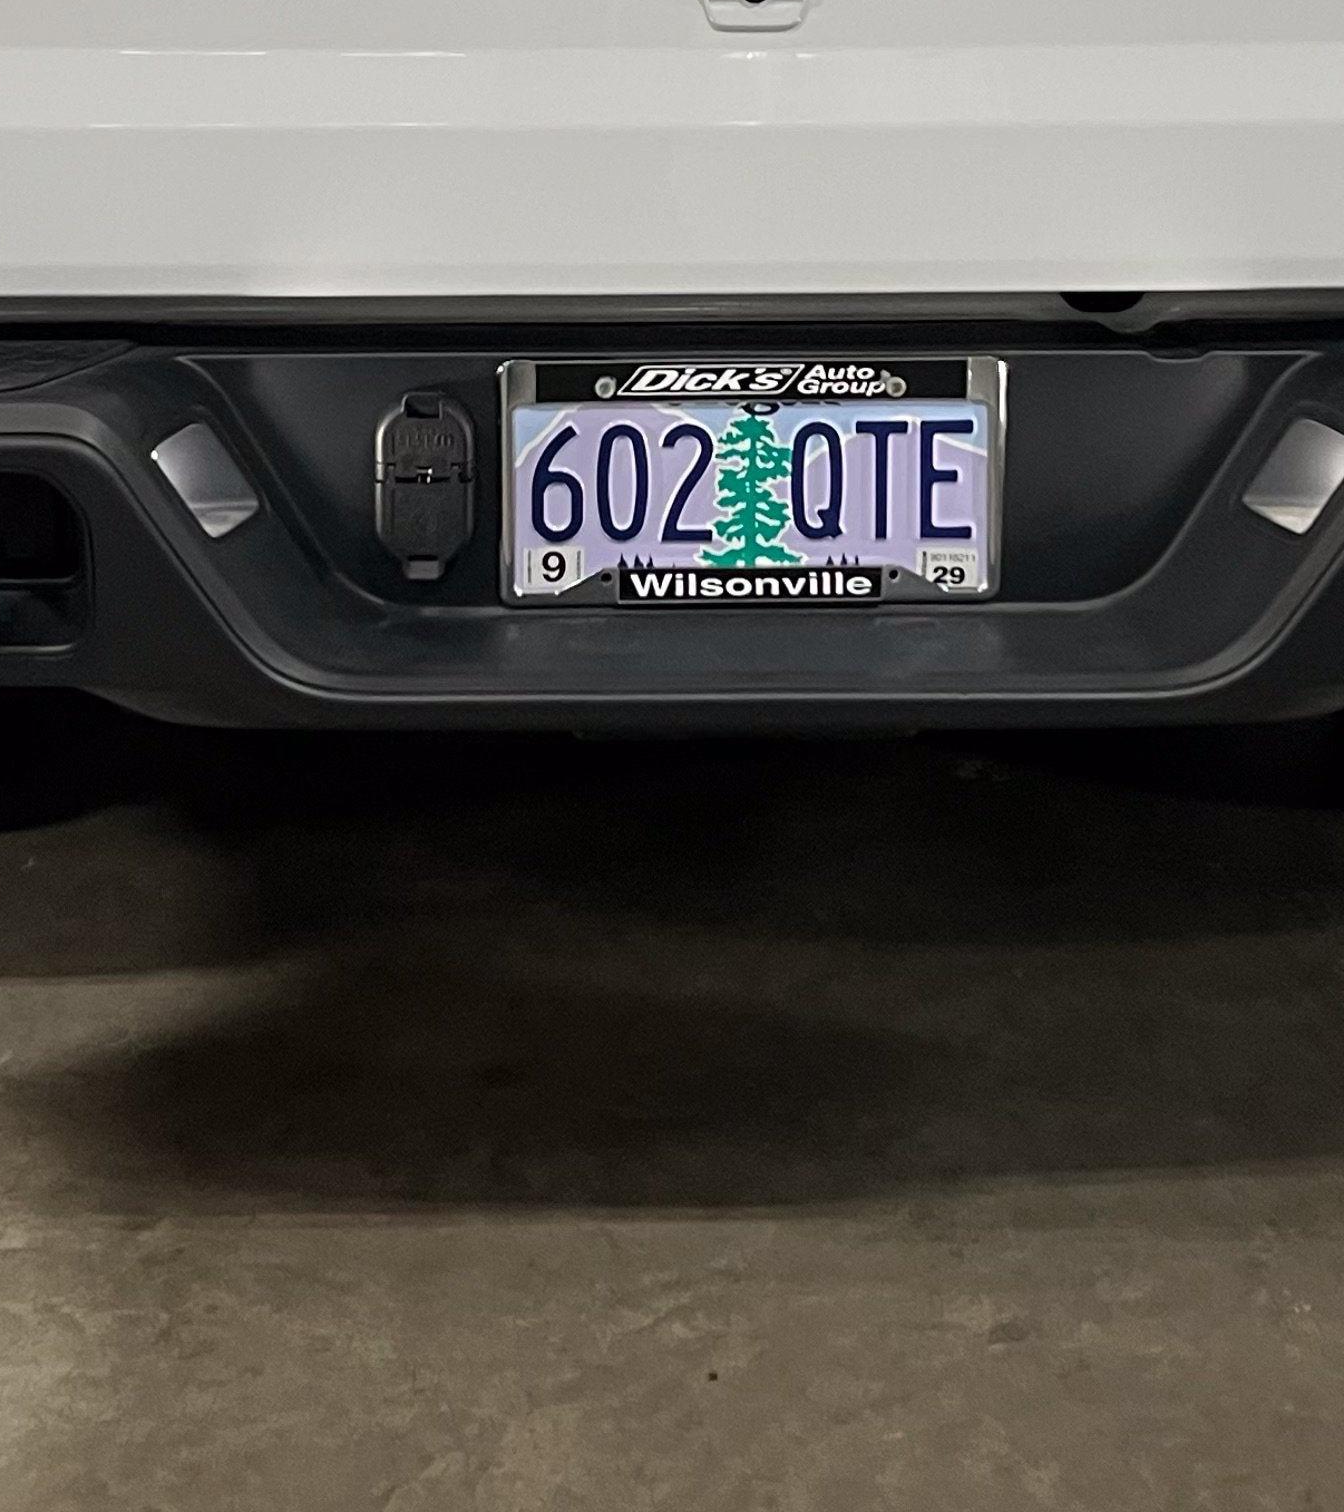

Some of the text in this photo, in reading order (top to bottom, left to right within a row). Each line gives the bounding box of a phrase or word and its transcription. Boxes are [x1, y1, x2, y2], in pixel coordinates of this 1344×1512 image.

[629, 367, 785, 392] Dick's
[803, 364, 876, 380] Auto
[796, 379, 888, 397] Group
[530, 419, 976, 543] 602 QTE
[541, 550, 567, 583] 9
[933, 565, 966, 585] 29
[629, 571, 873, 598] Wilsonville
